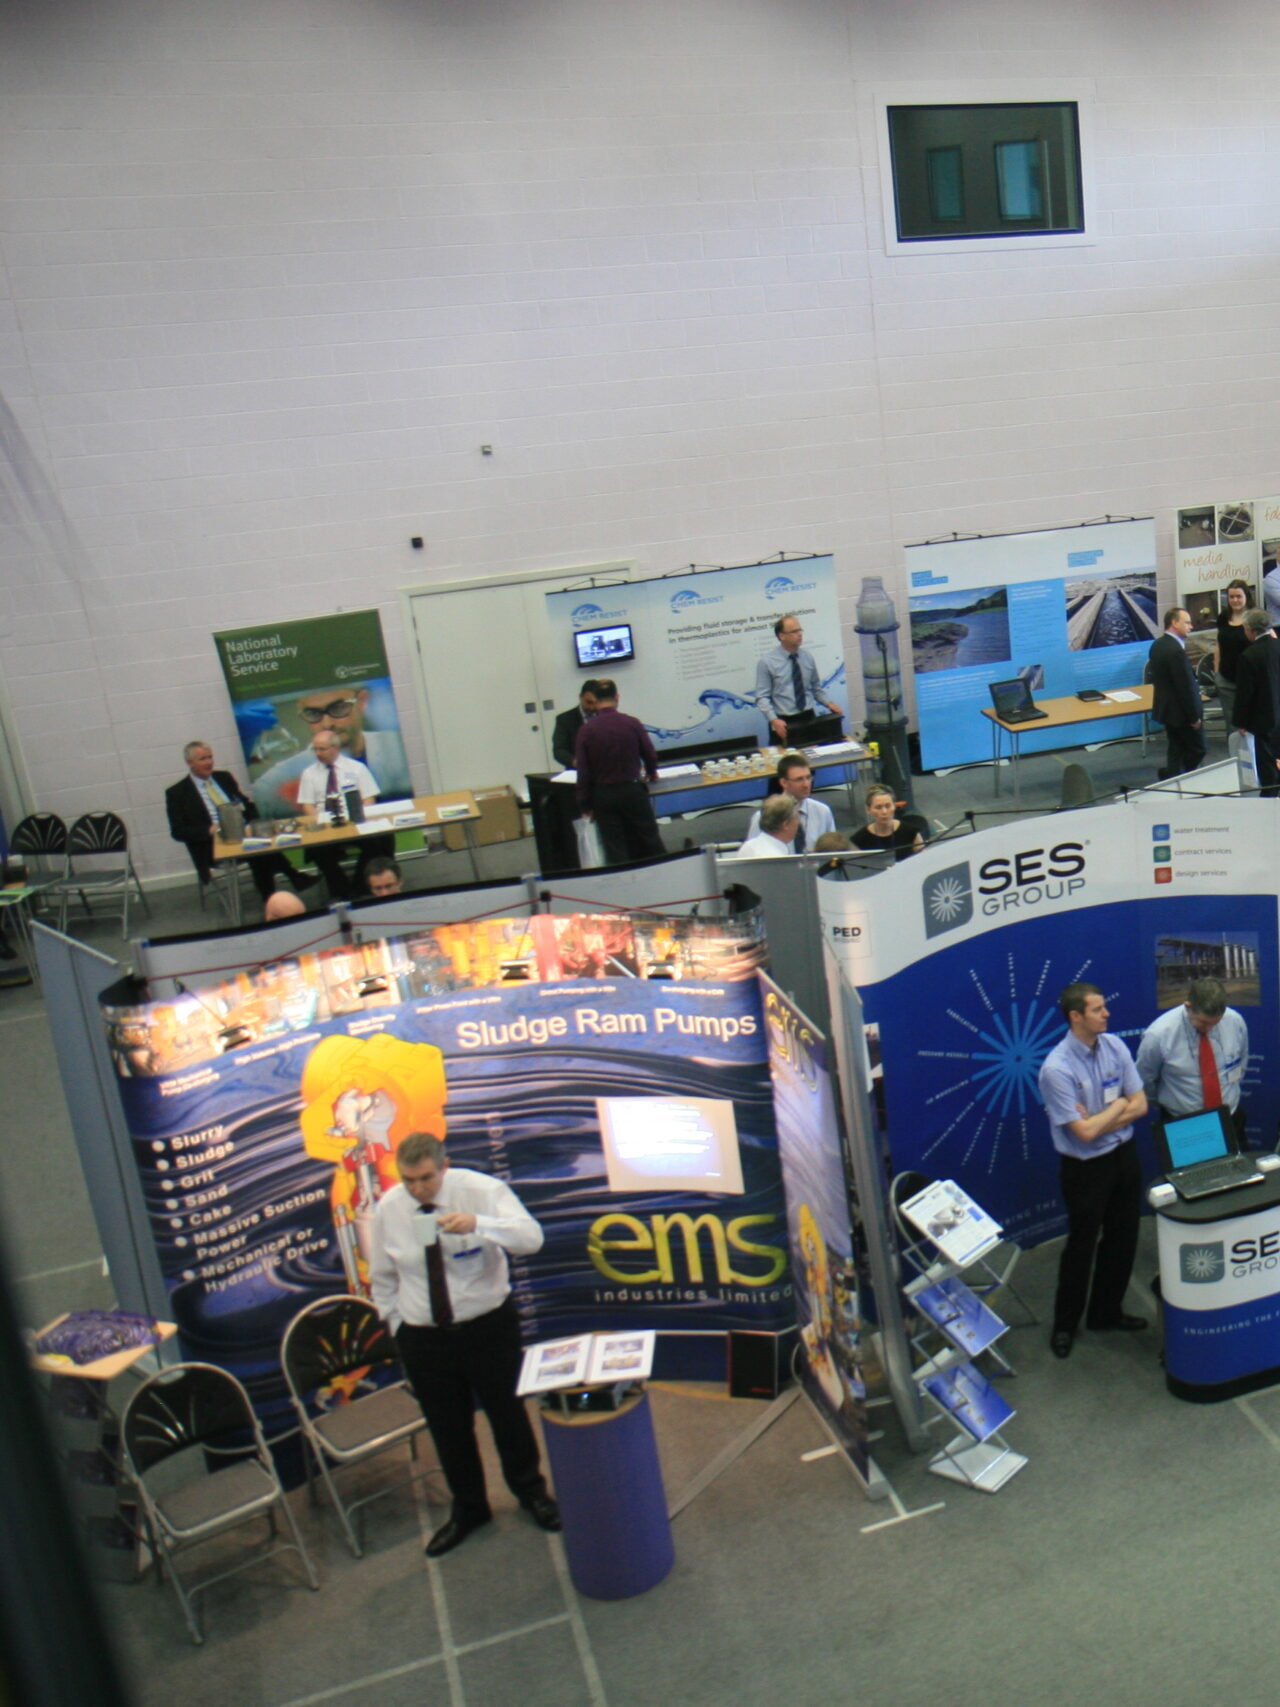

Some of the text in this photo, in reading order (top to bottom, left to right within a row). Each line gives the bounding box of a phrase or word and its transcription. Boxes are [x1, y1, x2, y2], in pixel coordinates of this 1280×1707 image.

[1183, 551, 1223, 567] media
[1198, 565, 1250, 582] handling
[670, 600, 695, 609] CHEM
[571, 614, 596, 623] CHEM
[667, 622, 702, 635] Providing
[703, 620, 720, 630] fluid
[720, 617, 748, 630] storage
[749, 616, 755, 624] &
[225, 633, 281, 653] National
[678, 629, 730, 644] thermoplastics
[731, 628, 742, 637] for
[743, 623, 768, 634] almost
[228, 645, 298, 666] Laboratory
[230, 660, 279, 677] Service
[978, 842, 1086, 895] SES
[1175, 870, 1199, 878] design
[982, 877, 1086, 917] GROUP
[832, 926, 861, 937] PED
[456, 1008, 757, 1049] Sludge Ram Pumps
[171, 1124, 225, 1150] Slurry
[175, 1141, 235, 1170] Sludge
[180, 1169, 215, 1189] Grit
[184, 1184, 229, 1208] Sand
[189, 1204, 232, 1227] Cake
[193, 1188, 326, 1245] Massive Suction
[196, 1234, 248, 1260] Power
[201, 1228, 313, 1279] Mechanical or
[587, 1212, 787, 1287] ems
[205, 1238, 329, 1293] Hydraulic Drive
[594, 1284, 793, 1304] industries limited
[1183, 1319, 1252, 1335] ENGINEERING
[1254, 1314, 1272, 1323] THE
